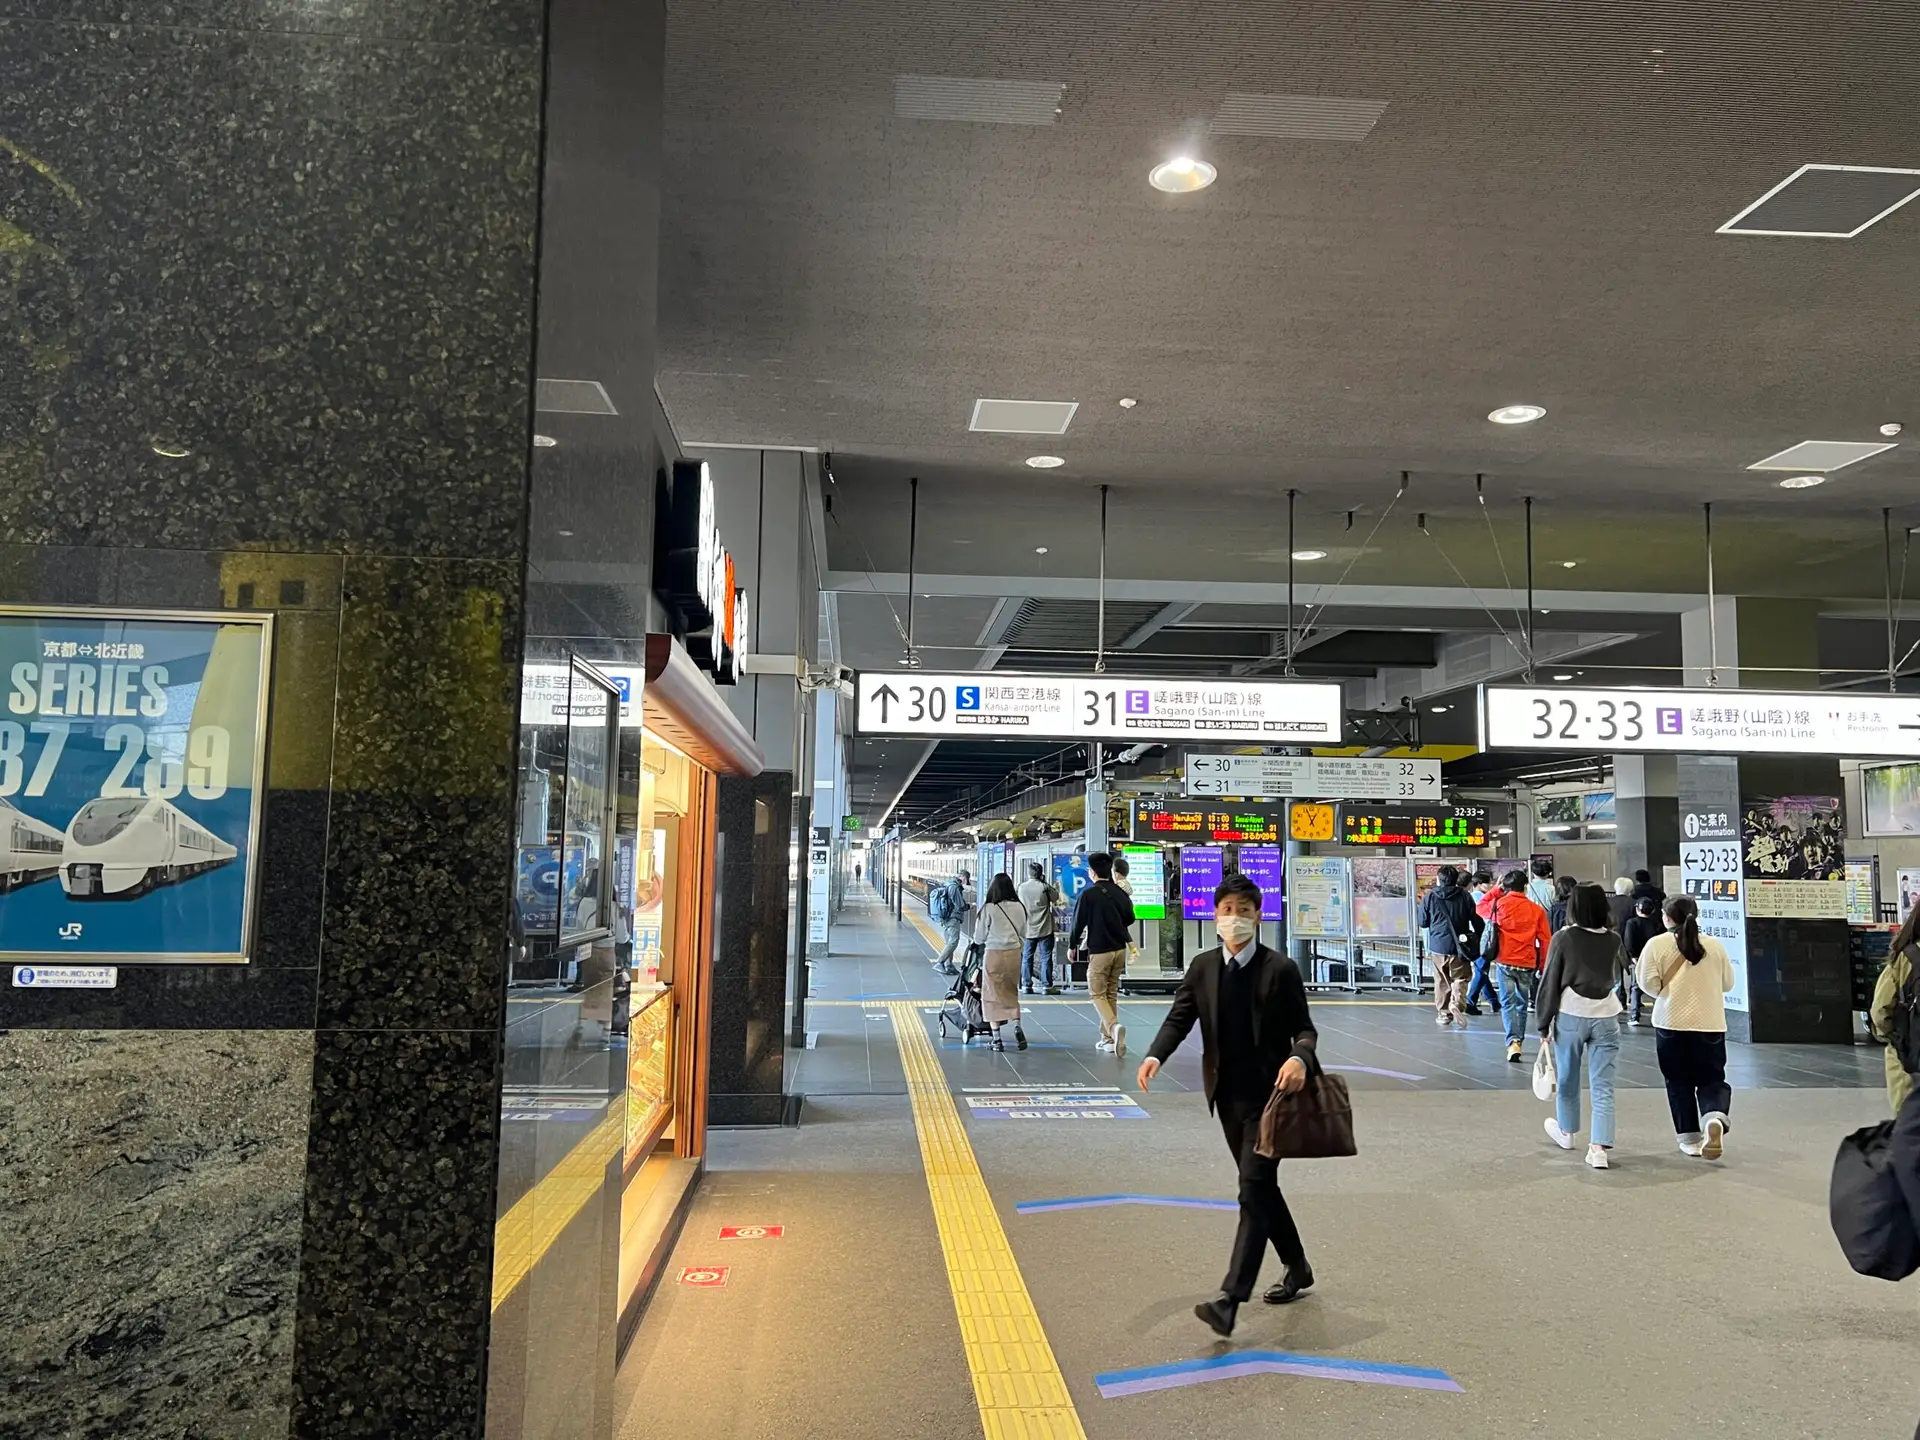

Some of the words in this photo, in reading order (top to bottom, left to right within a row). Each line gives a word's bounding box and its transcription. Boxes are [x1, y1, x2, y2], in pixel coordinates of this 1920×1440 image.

[43, 641, 77, 658] 京都
[94, 642, 145, 660] 北近畿
[8, 661, 169, 717] SERIES
[984, 686, 1061, 701] 関西空港線
[908, 686, 946, 722] 30
[962, 688, 974, 707] S
[1131, 693, 1144, 711] E
[1044, 703, 1061, 713] Line
[1083, 690, 1117, 726] 31
[1154, 706, 1194, 718] Sagano
[1198, 706, 1240, 718] (San-in)
[1243, 708, 1265, 718] Line
[1661, 710, 1677, 732] E
[1847, 711, 1882, 723] お手洗
[1691, 726, 1737, 740] Sagano
[1740, 726, 1788, 740] (San-in)
[1790, 727, 1816, 740] Line
[1847, 724, 1889, 734] Restroom
[101, 723, 231, 800] 289
[1214, 759, 1230, 772] 30
[1398, 763, 1414, 776] 32
[1214, 780, 1230, 792] 31
[1398, 782, 1415, 796] 33
[1208, 814, 1230, 822] 13:00
[1346, 818, 1355, 826] 32
[1700, 812, 1728, 826] ご案内
[1700, 827, 1736, 838] Information
[1714, 880, 1736, 894] 快速
[58, 922, 82, 936] JR
